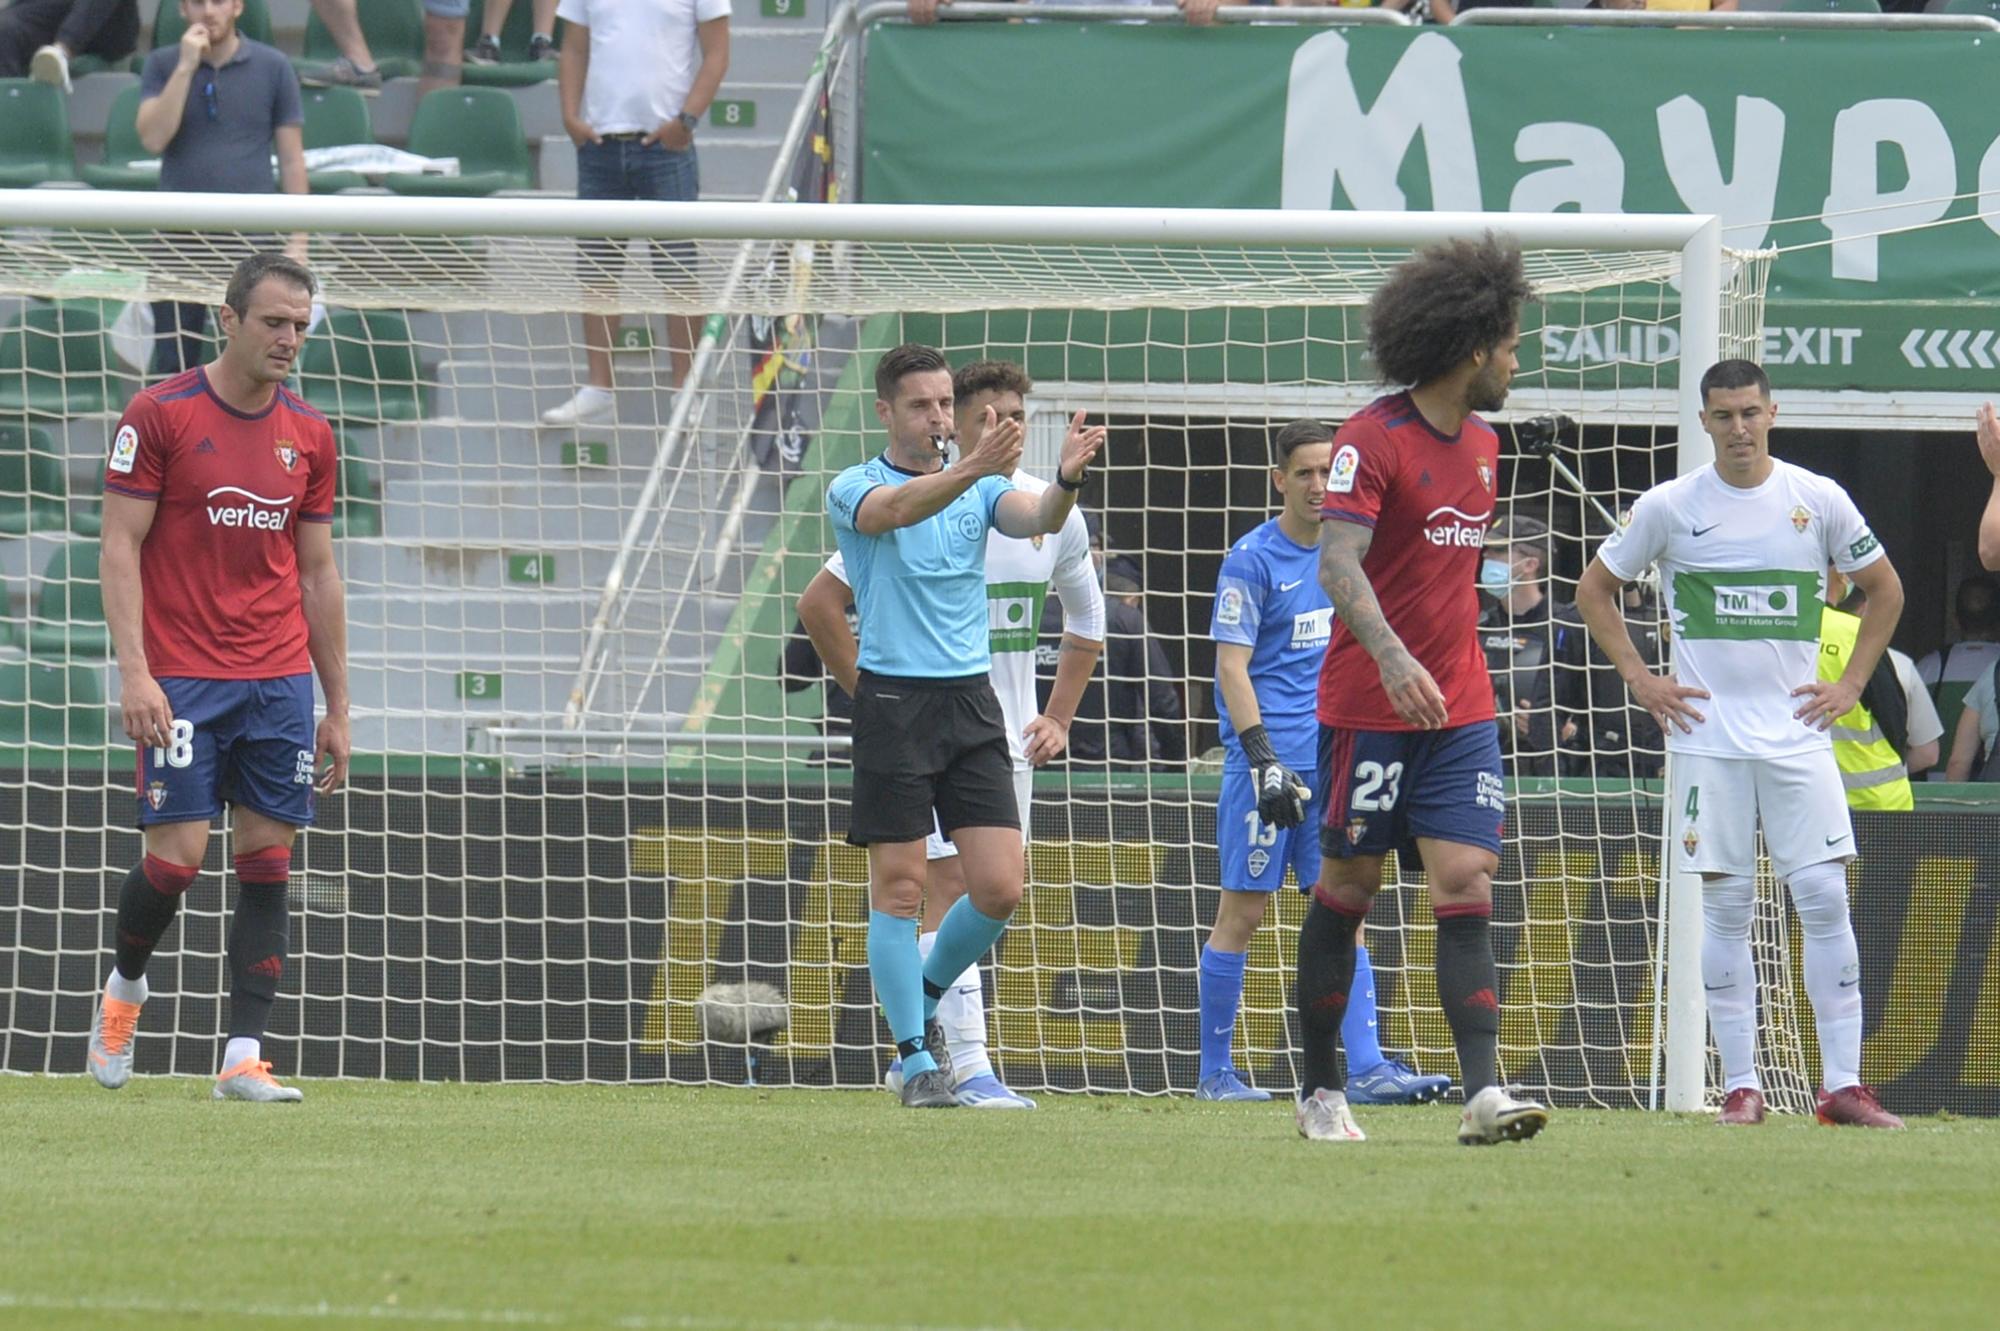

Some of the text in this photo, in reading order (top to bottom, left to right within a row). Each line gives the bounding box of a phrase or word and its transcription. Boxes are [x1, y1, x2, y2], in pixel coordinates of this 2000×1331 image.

[726, 104, 739, 123] 8
[1282, 29, 2000, 293] Mayp
[625, 331, 639, 349] 6
[1541, 325, 1680, 363] SALID
[1762, 327, 1862, 366] EXIT
[578, 446, 591, 464] 5
[207, 503, 289, 531] verleal
[524, 559, 539, 579] 4
[1720, 595, 1748, 610] TM
[1299, 619, 1316, 634] TM
[1749, 618, 1773, 626] Estate
[1774, 618, 1798, 628] Group
[471, 675, 486, 696] 3
[1351, 760, 1404, 812] 23
[1685, 786, 1699, 823] 4
